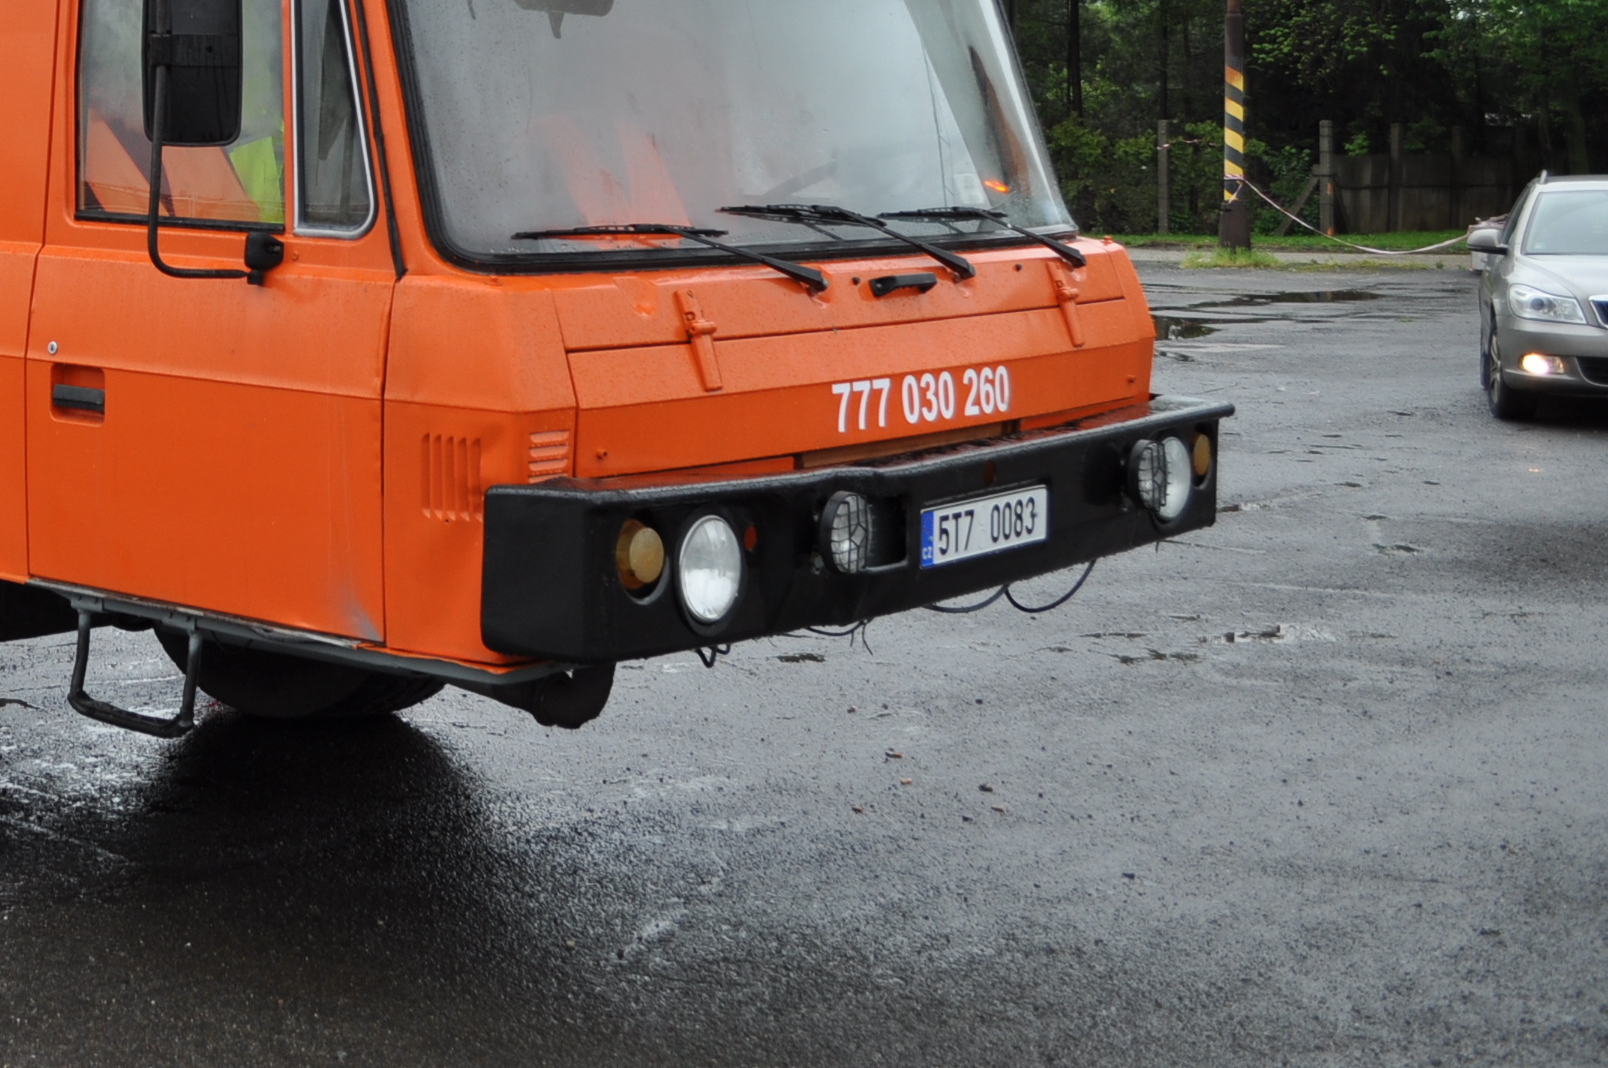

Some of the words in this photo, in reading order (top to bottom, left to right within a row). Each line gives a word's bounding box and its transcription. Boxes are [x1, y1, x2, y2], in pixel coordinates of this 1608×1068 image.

[831, 378, 890, 433] 777
[901, 370, 955, 424] 030
[962, 365, 1010, 417] 260
[921, 545, 933, 560] CZ
[938, 509, 975, 556] 5T7
[990, 496, 1036, 543] 0083
